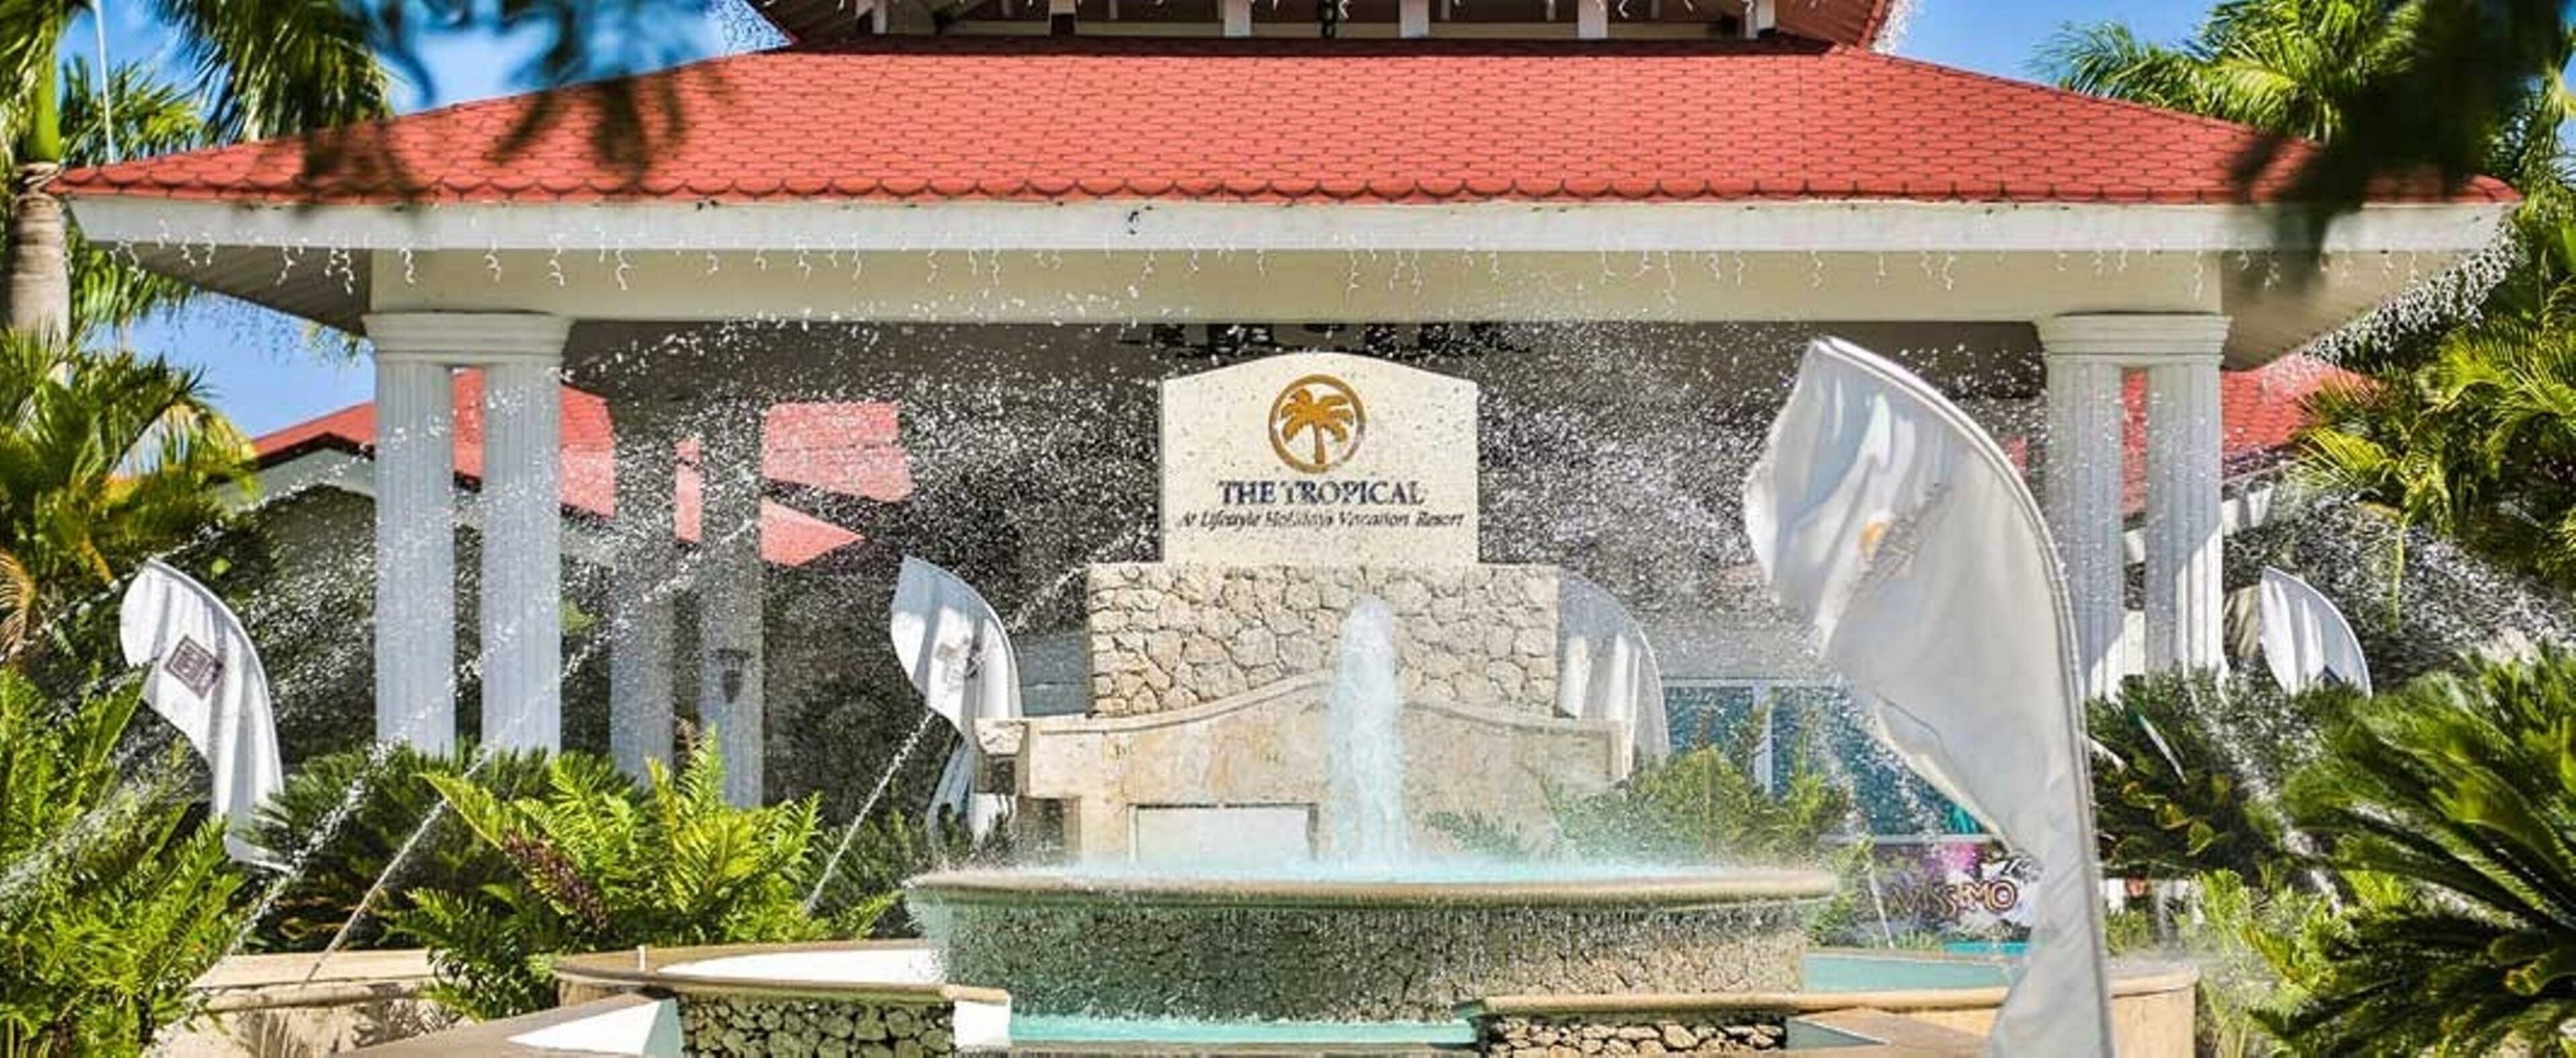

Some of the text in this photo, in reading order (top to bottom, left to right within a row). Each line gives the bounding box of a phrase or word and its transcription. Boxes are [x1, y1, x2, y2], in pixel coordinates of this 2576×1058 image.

[1217, 480, 1425, 504] THE TROPICAL
[1199, 509, 1260, 532] Lifestyle
[1339, 510, 1410, 528] Vacation
[1415, 511, 1465, 527] Resort
